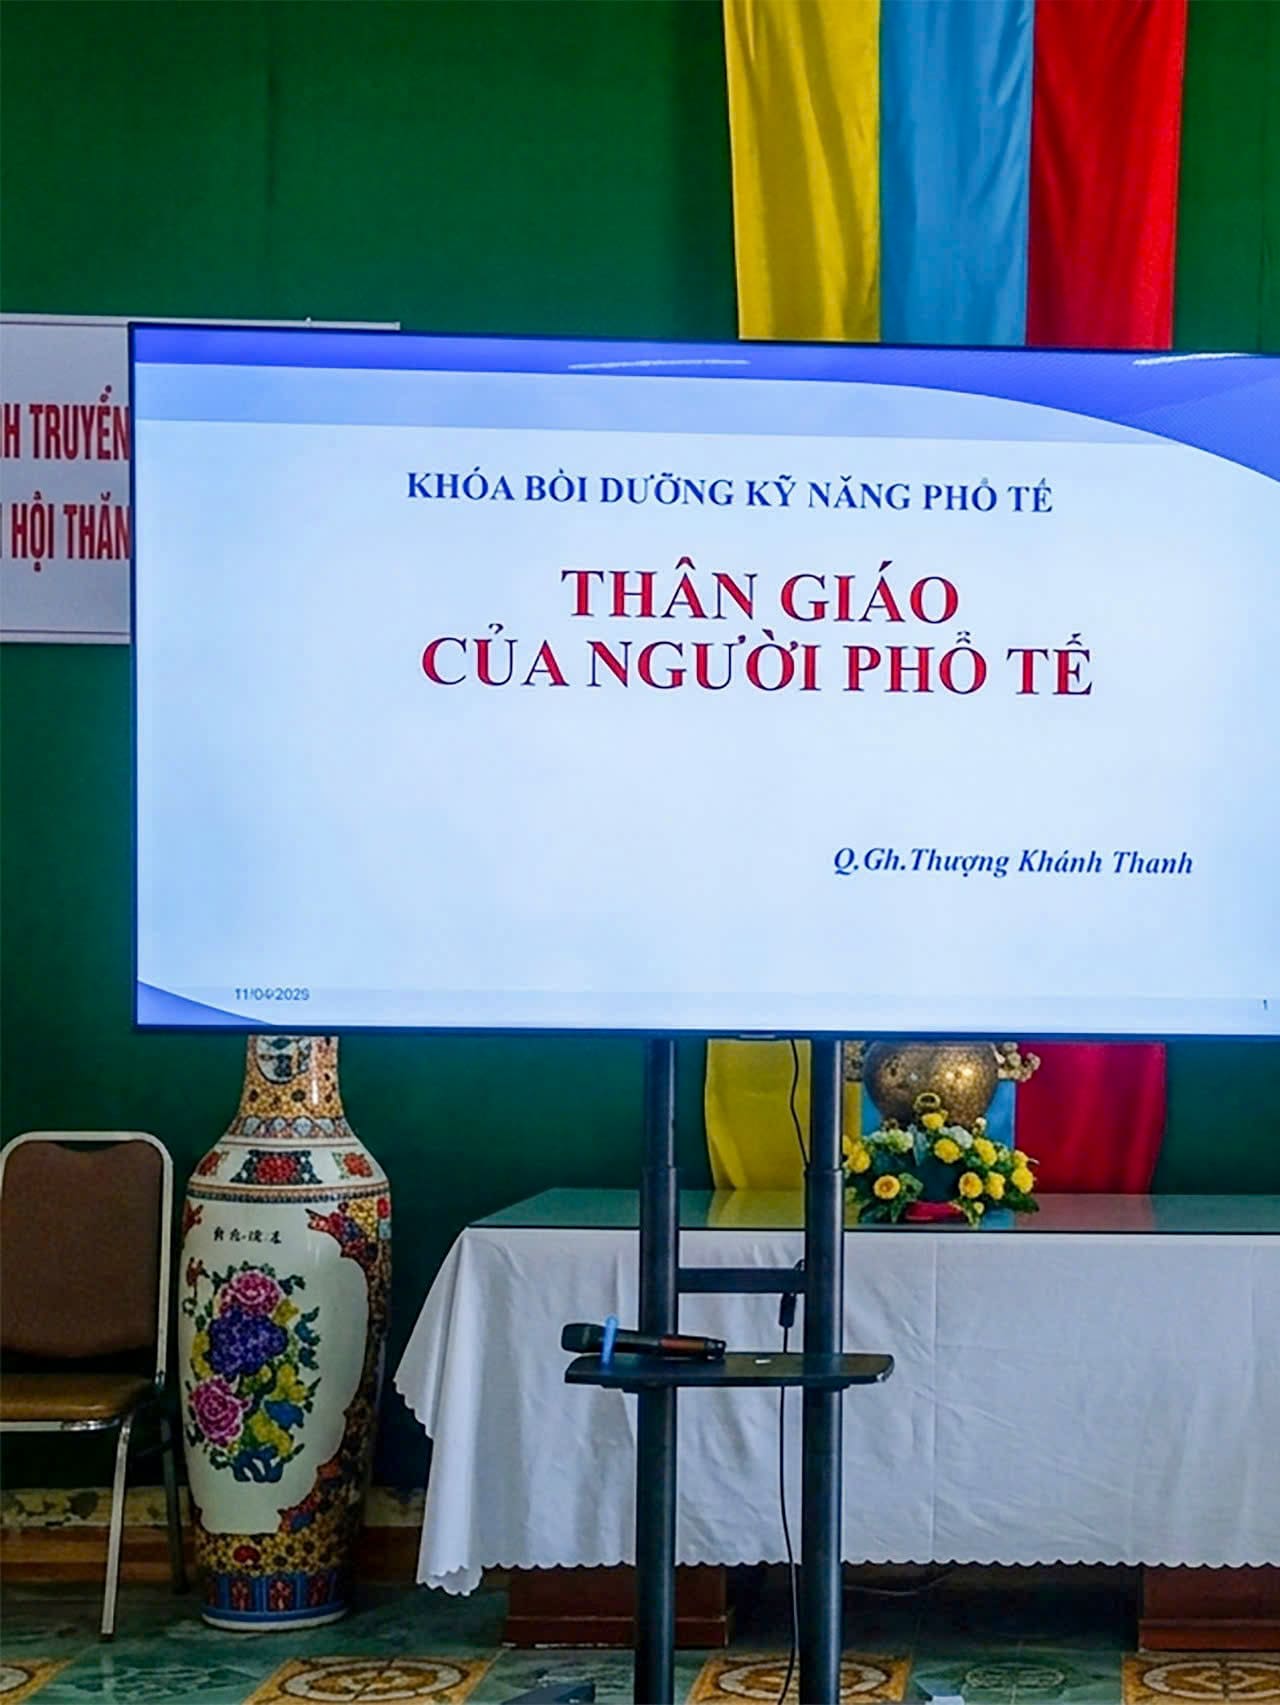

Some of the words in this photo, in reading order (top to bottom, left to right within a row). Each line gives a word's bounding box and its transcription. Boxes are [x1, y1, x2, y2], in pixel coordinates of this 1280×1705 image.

[408, 467, 514, 500] KHÓA
[601, 472, 733, 505] DƯỠNG
[747, 475, 795, 506] KỸ
[809, 476, 909, 509] NĂNG
[12, 491, 54, 572] HỘI
[562, 557, 757, 619] THÂN
[781, 561, 958, 624] GIÁO
[422, 624, 569, 686] CỦA
[587, 629, 820, 691] NGƯỜI
[1007, 633, 1092, 695] TẾ
[1019, 850, 1101, 872] Khánh
[1114, 851, 1192, 874] Thanh
